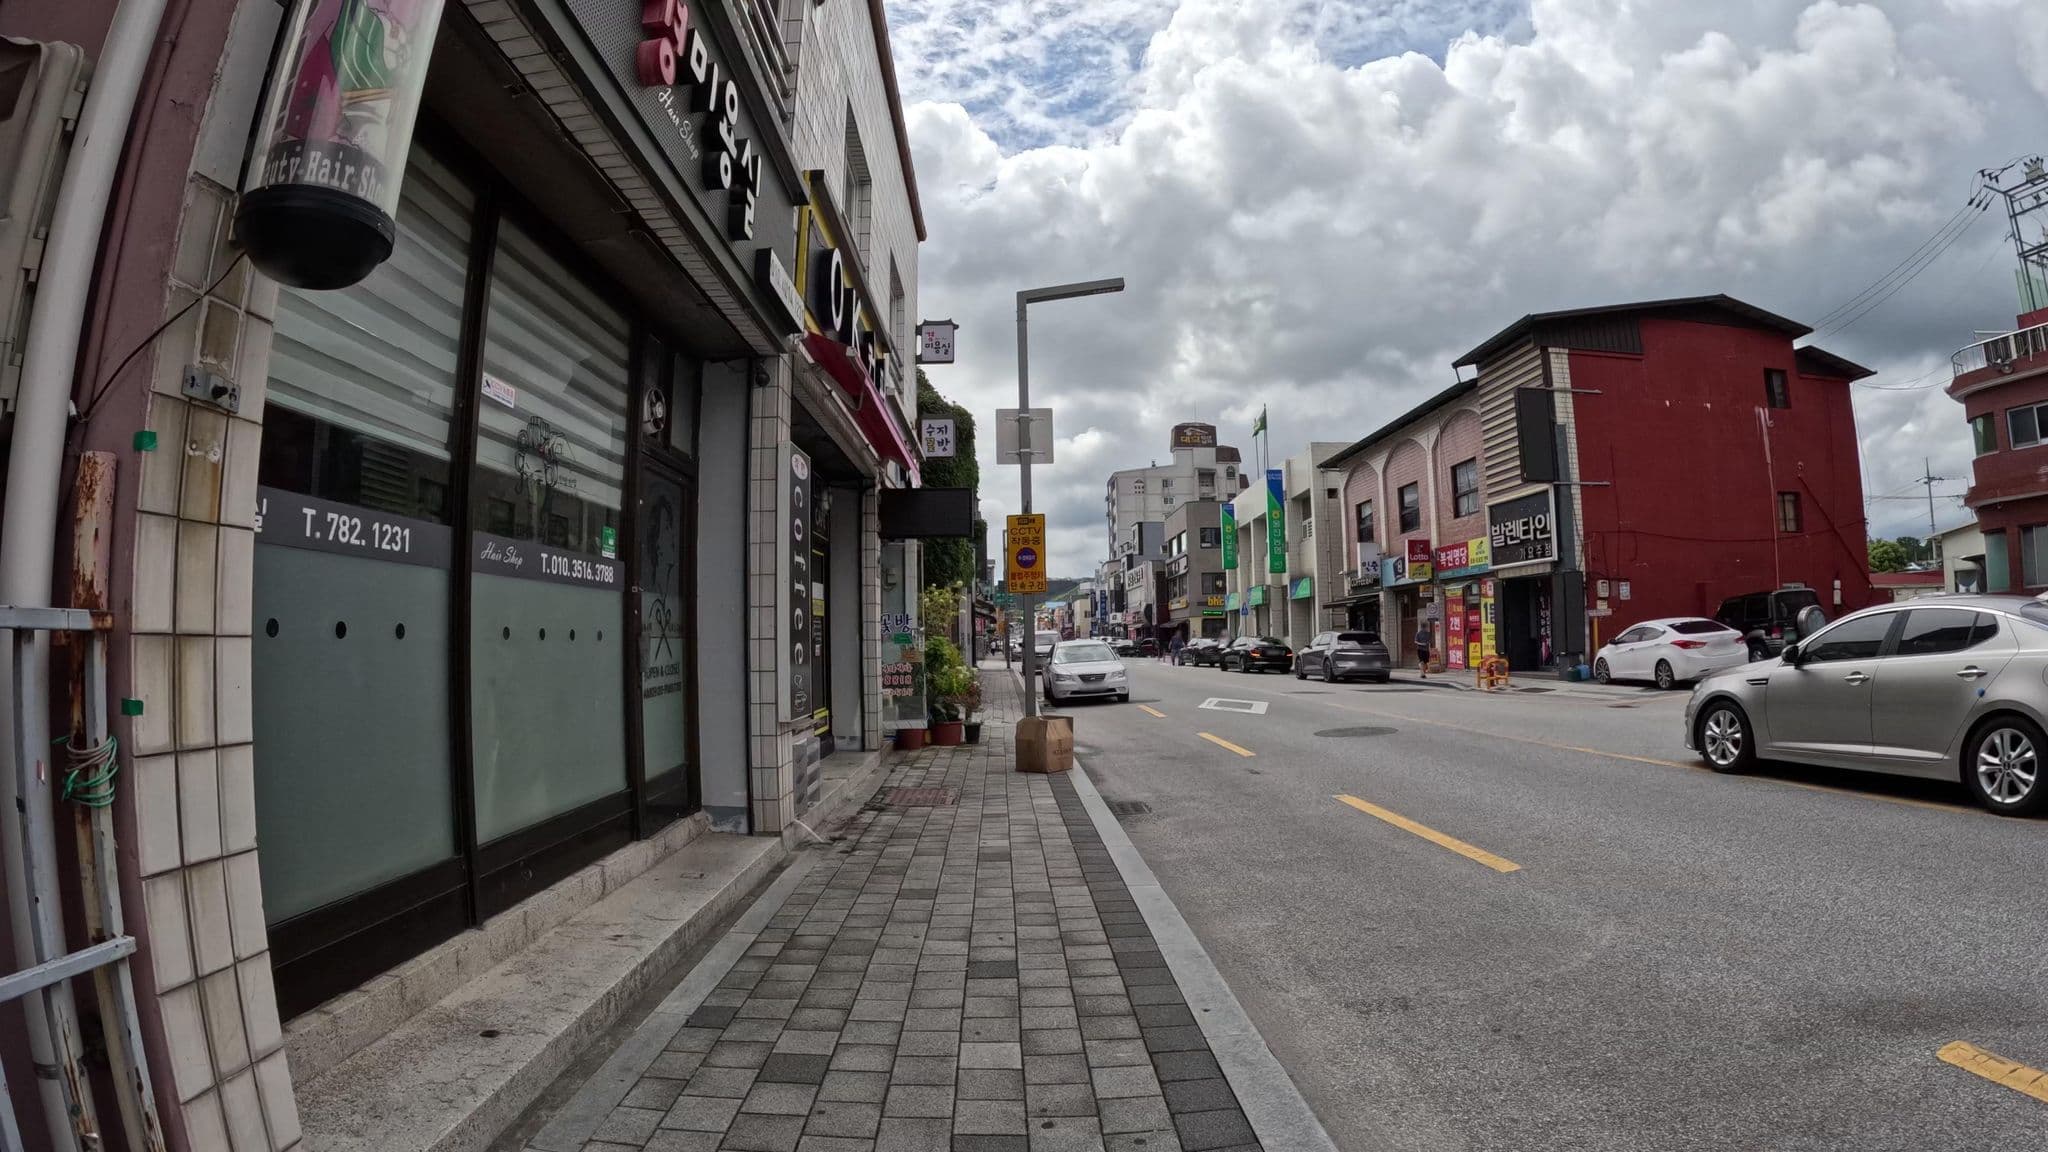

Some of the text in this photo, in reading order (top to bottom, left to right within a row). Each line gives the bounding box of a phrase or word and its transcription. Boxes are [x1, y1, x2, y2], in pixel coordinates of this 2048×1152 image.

[658, 88, 699, 160] Hair Shop
[925, 341, 951, 355] 미용실
[926, 424, 948, 437] 수지
[302, 507, 410, 553] T. 782. 1231
[1010, 527, 1042, 535] CCTV
[1491, 512, 1551, 548] 발렌타인
[1011, 536, 1041, 545] 작동중
[480, 541, 523, 569] Hair Shop
[1439, 546, 1467, 567] 복권명당
[1520, 543, 1552, 560] 가요주점
[794, 486, 806, 665] coffee
[1010, 581, 1044, 591] 단속구간
[1207, 595, 1225, 606] bhc
